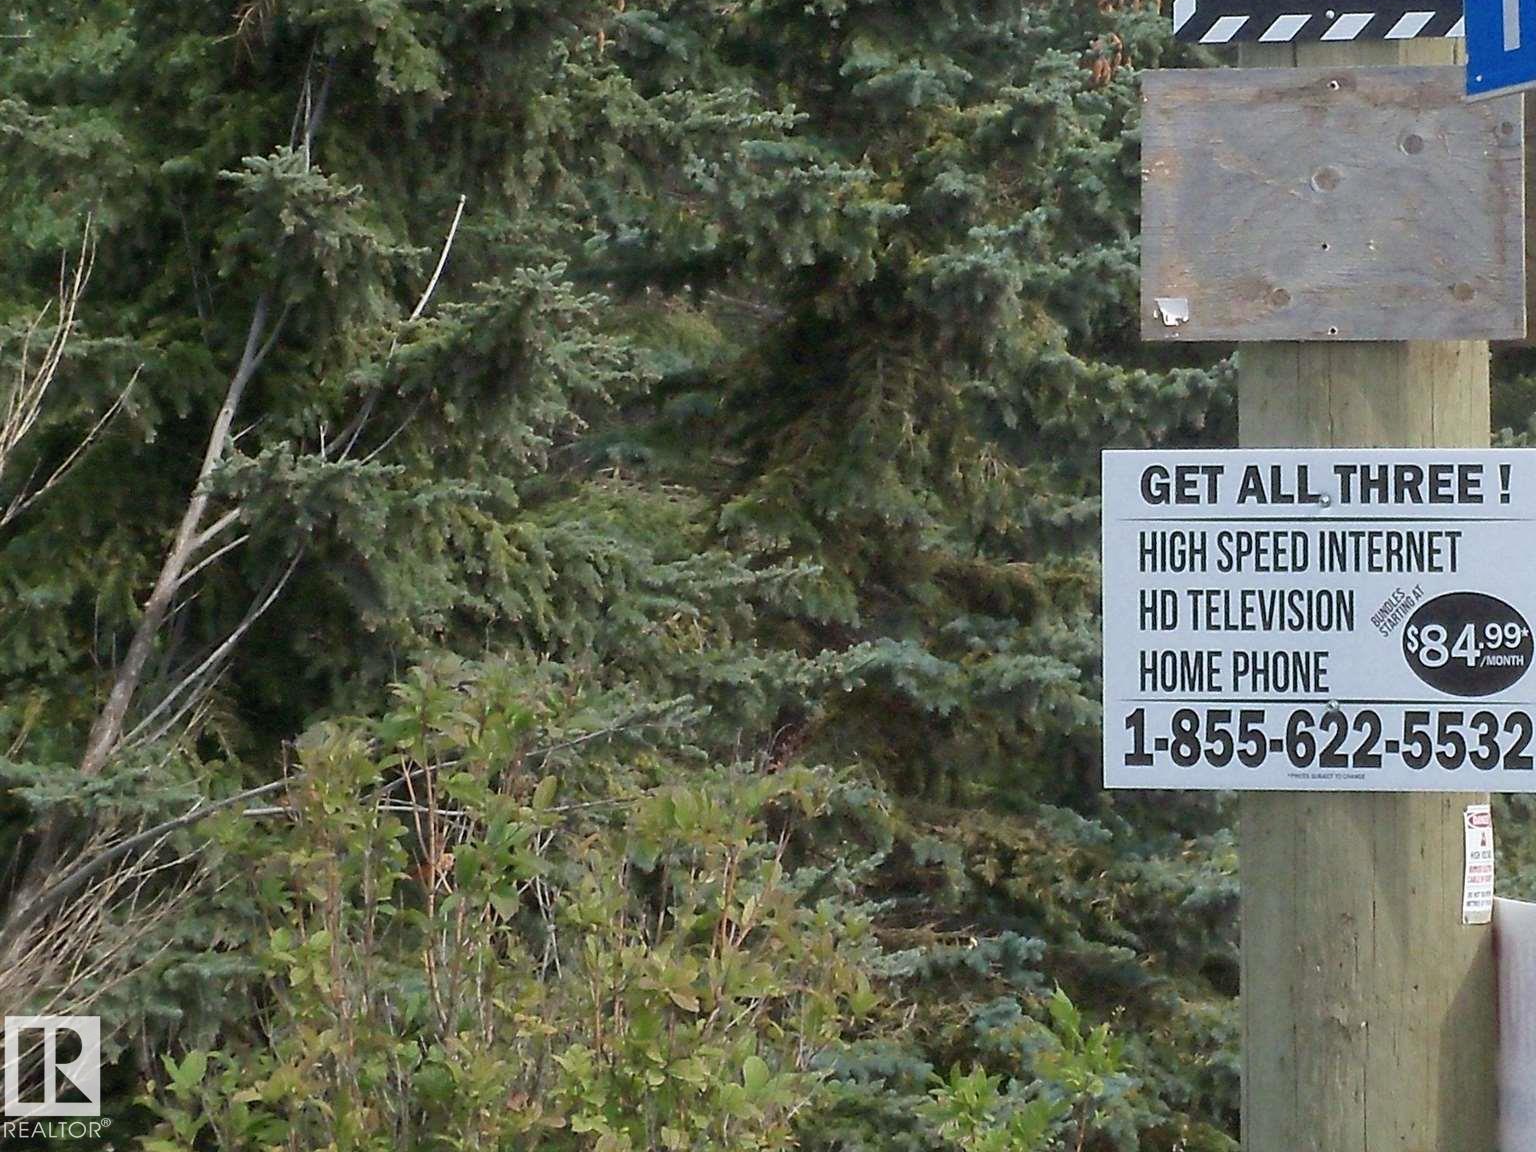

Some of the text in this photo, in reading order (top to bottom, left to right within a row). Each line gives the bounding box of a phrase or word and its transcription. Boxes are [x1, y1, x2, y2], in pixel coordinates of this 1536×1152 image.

[1140, 464, 1224, 504] GET
[1237, 464, 1321, 504] ALL
[1333, 464, 1483, 504] THREE
[1139, 530, 1462, 573] HIGH SPEED INTERNET
[1139, 589, 1354, 631] HD TELEVISION
[1370, 587, 1406, 628] BUNDLES
[1379, 584, 1425, 638] STARTING AT
[1139, 650, 1329, 693] HOME PHONE
[1123, 708, 1534, 770] 1-855-622-5532
